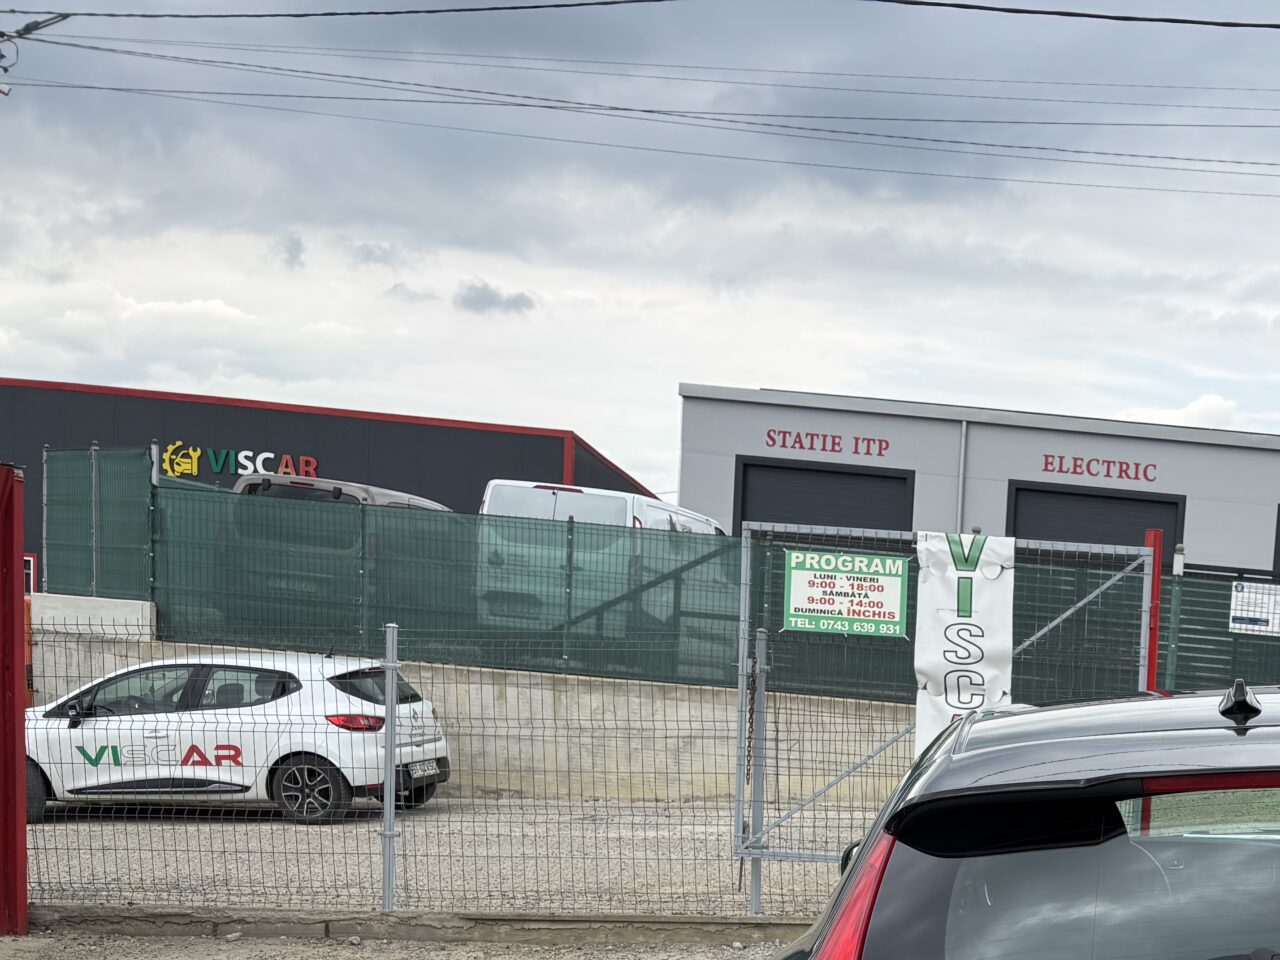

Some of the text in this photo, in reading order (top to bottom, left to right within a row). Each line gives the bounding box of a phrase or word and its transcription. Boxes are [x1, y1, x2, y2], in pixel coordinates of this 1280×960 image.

[765, 428, 890, 457] STATIE ITP
[206, 447, 318, 478] VISCAR
[1041, 453, 1157, 482] ELECTRIC
[790, 552, 903, 575] PROGRAM
[807, 580, 836, 590] 9:00
[848, 583, 885, 593] 18:00
[813, 573, 837, 581] LUNI
[845, 575, 879, 584] VINERI
[807, 596, 835, 606] 9:00
[848, 600, 884, 609] 14:00
[846, 607, 896, 620] ÎNCHIS
[789, 617, 900, 635] TEL: 0743 639 931
[943, 533, 986, 723] VISC
[75, 744, 244, 768] VISCAR
